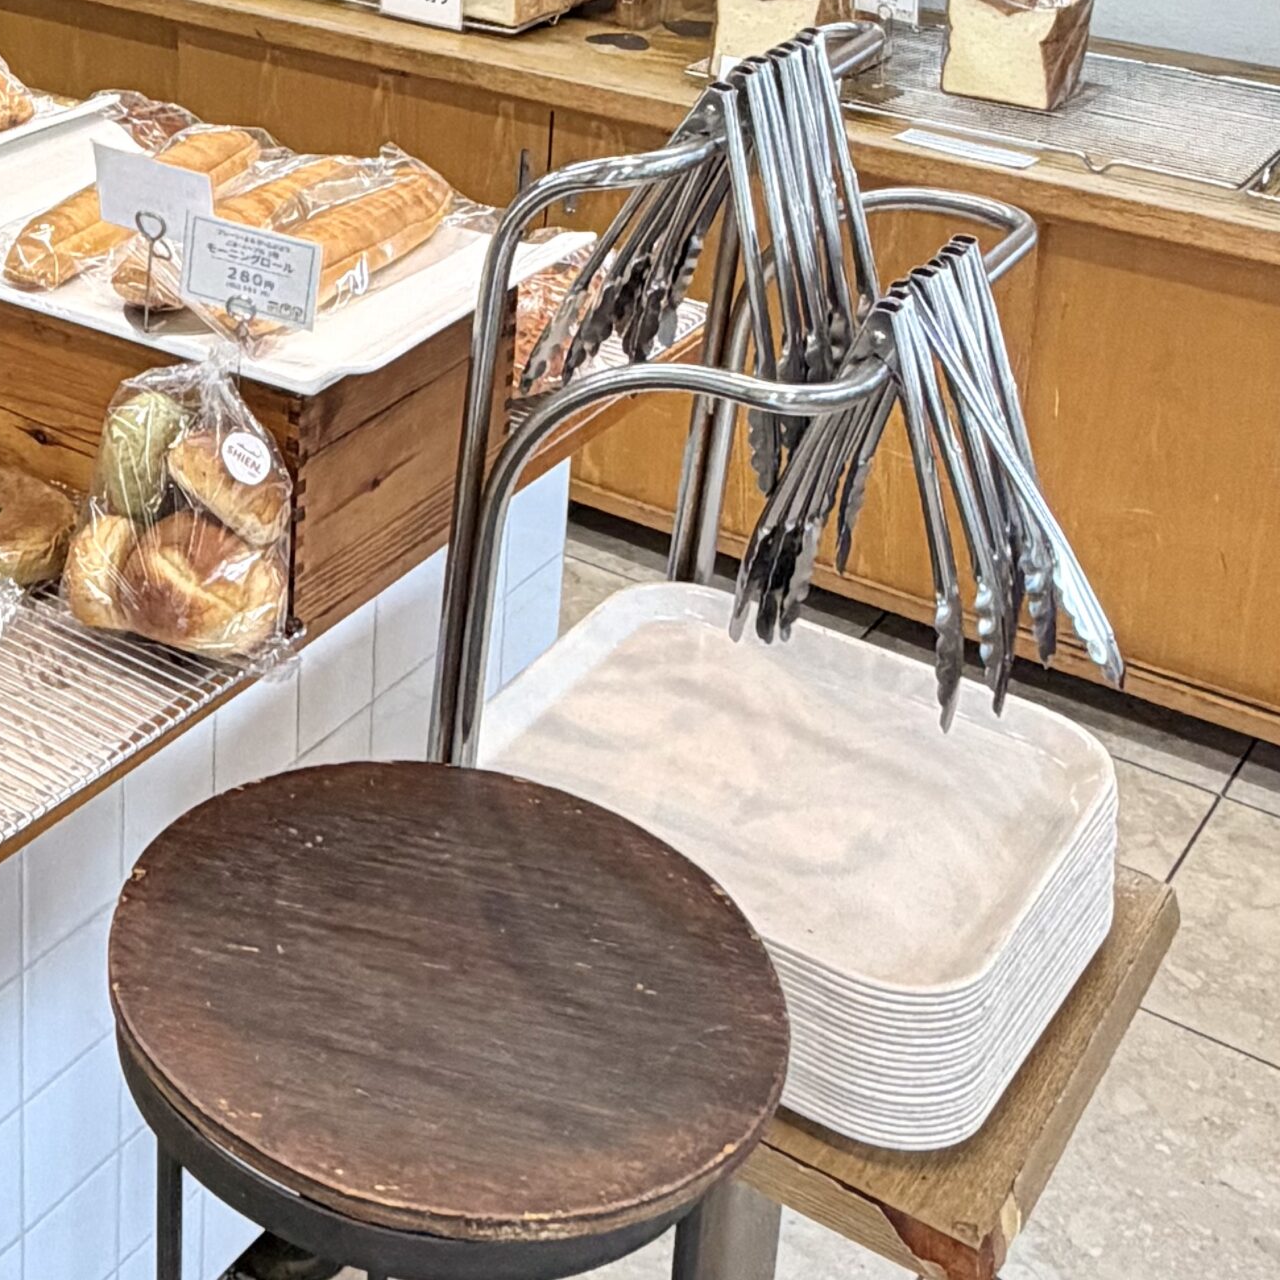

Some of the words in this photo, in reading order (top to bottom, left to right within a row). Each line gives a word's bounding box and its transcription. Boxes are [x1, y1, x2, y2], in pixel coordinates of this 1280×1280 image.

[207, 242, 296, 274] モーニングロール
[227, 266, 276, 292] 280円
[226, 445, 262, 475] SHIEN
